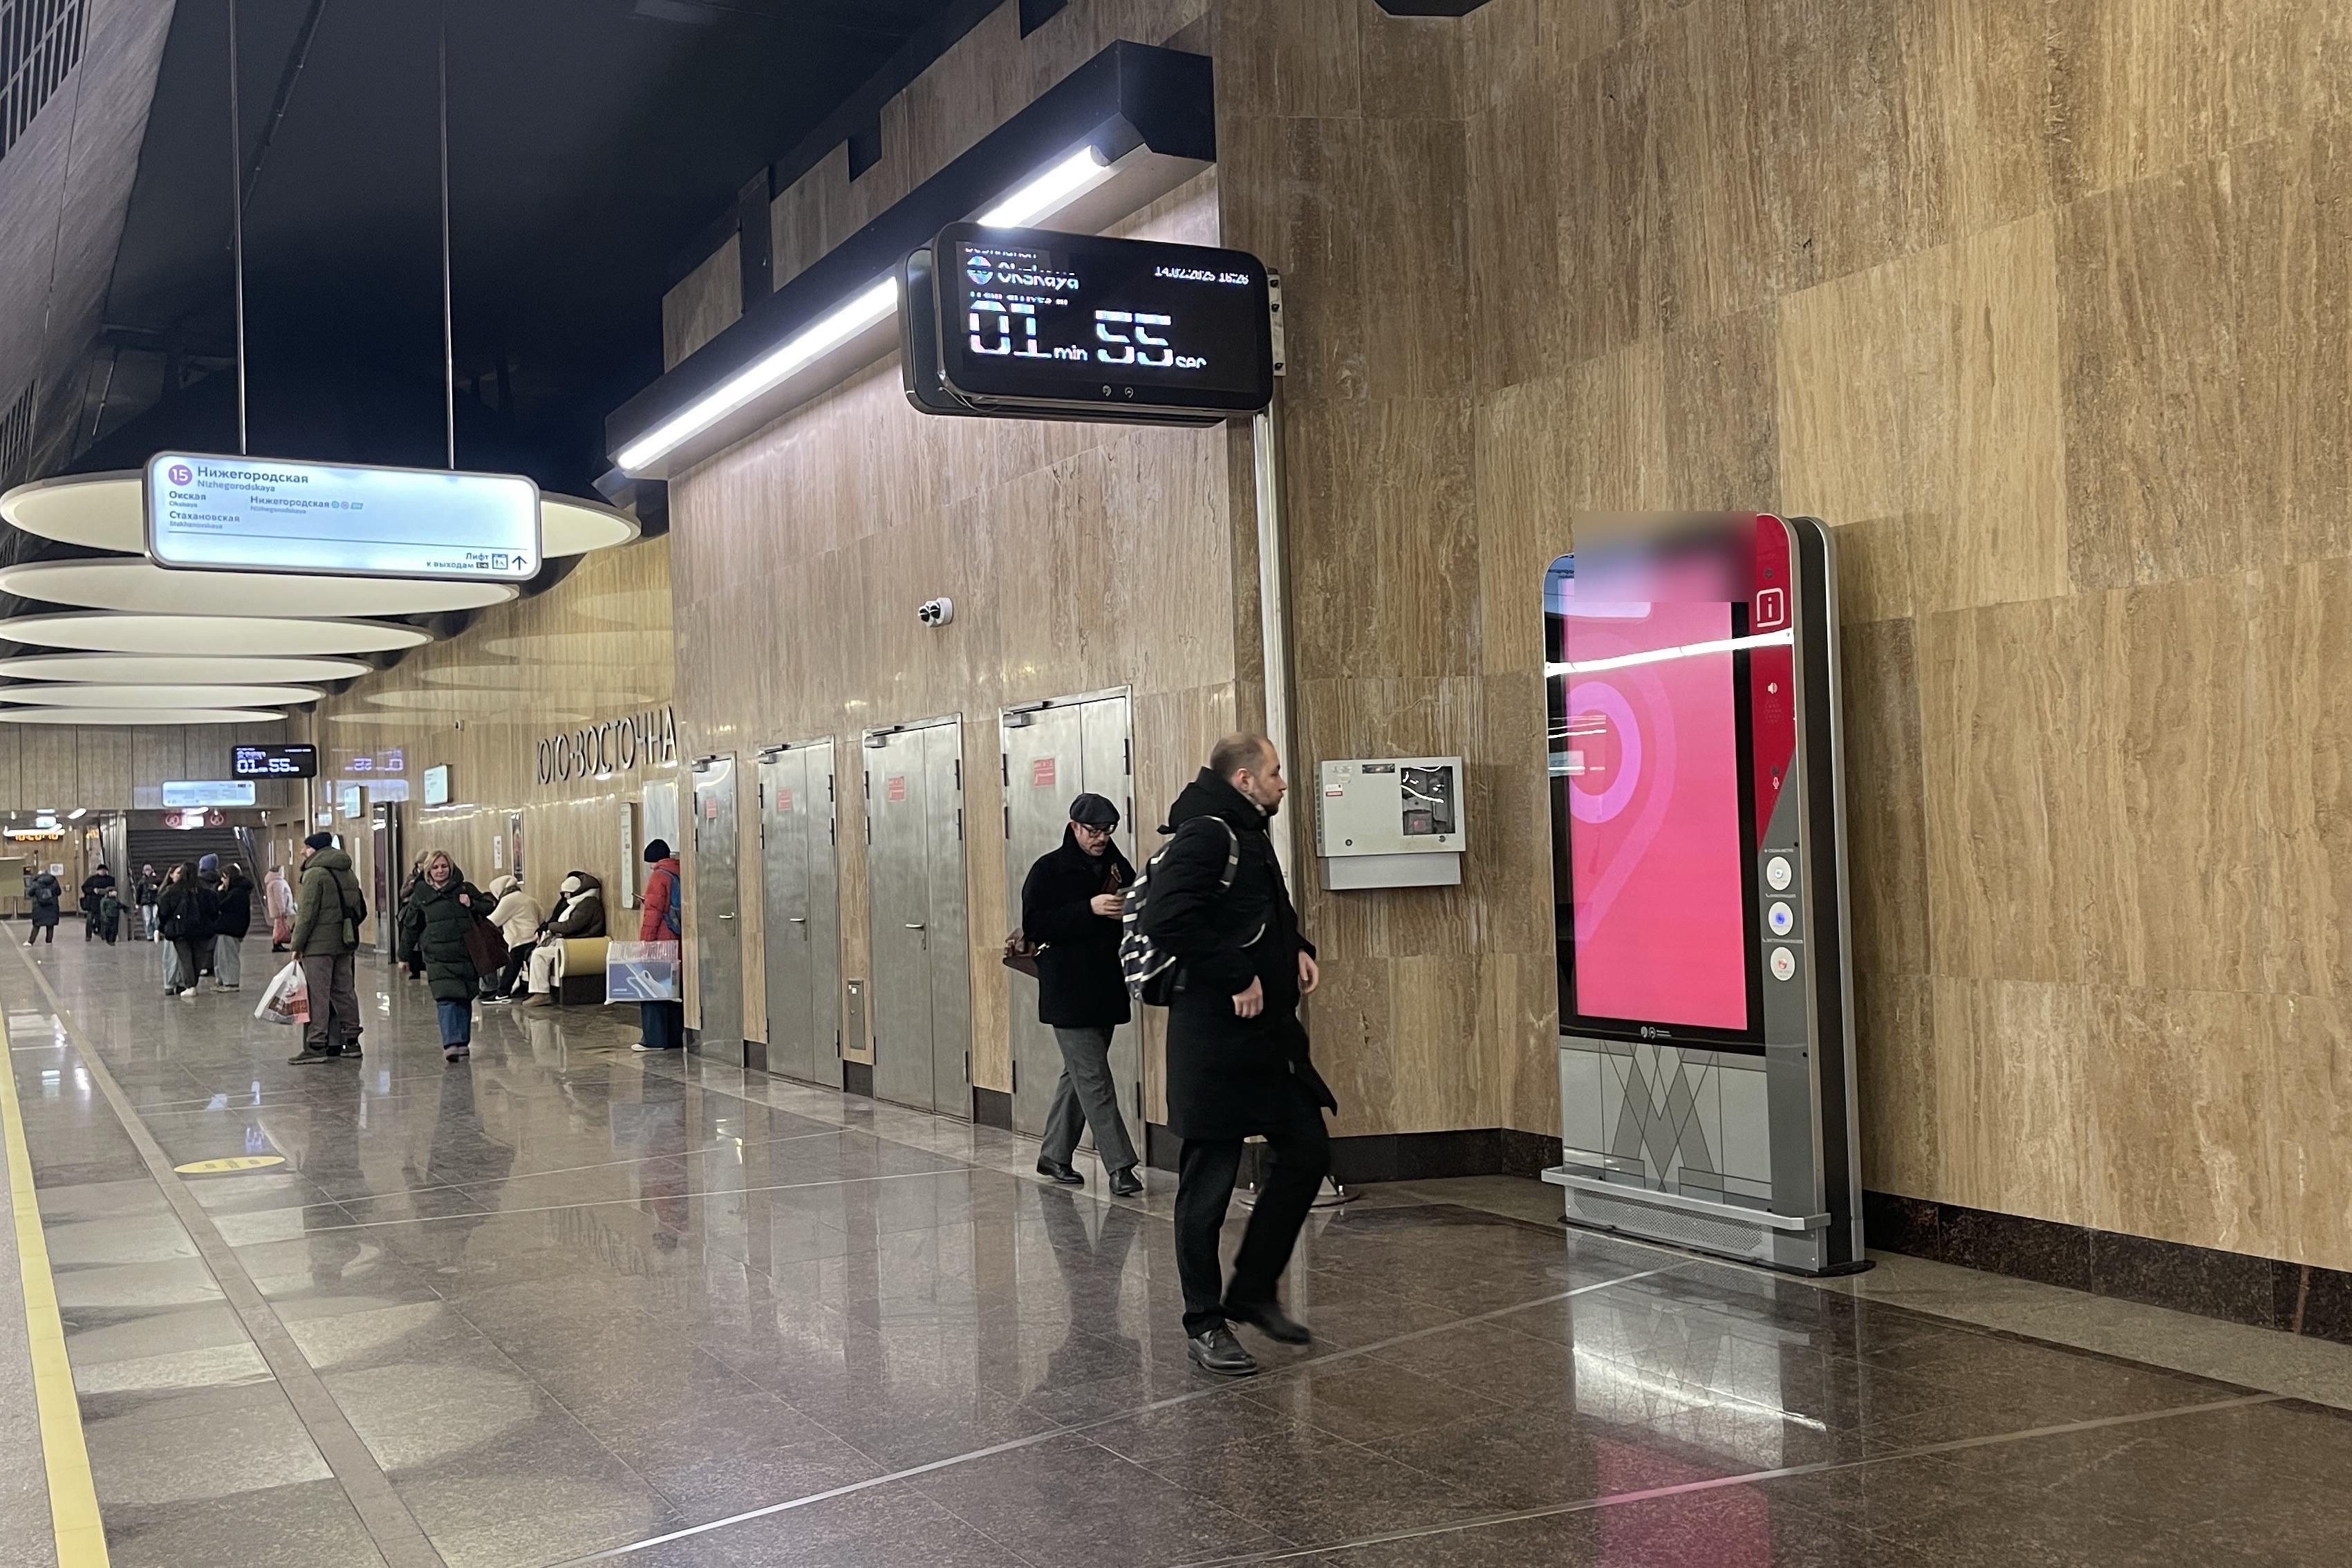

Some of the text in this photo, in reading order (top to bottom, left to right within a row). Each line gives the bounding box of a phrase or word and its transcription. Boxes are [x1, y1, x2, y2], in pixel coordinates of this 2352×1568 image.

[969, 299, 1052, 358] 01
[1054, 344, 1089, 360] min
[1095, 309, 1174, 367] 55
[171, 466, 308, 483] 15 Нижегородская
[198, 480, 275, 492] Nizhegorodskaya
[169, 490, 207, 501] Окская
[250, 496, 330, 508] Нижегородская
[169, 510, 240, 523] Стахановская
[465, 552, 489, 561] Лифт
[269, 758, 290, 772] 55
